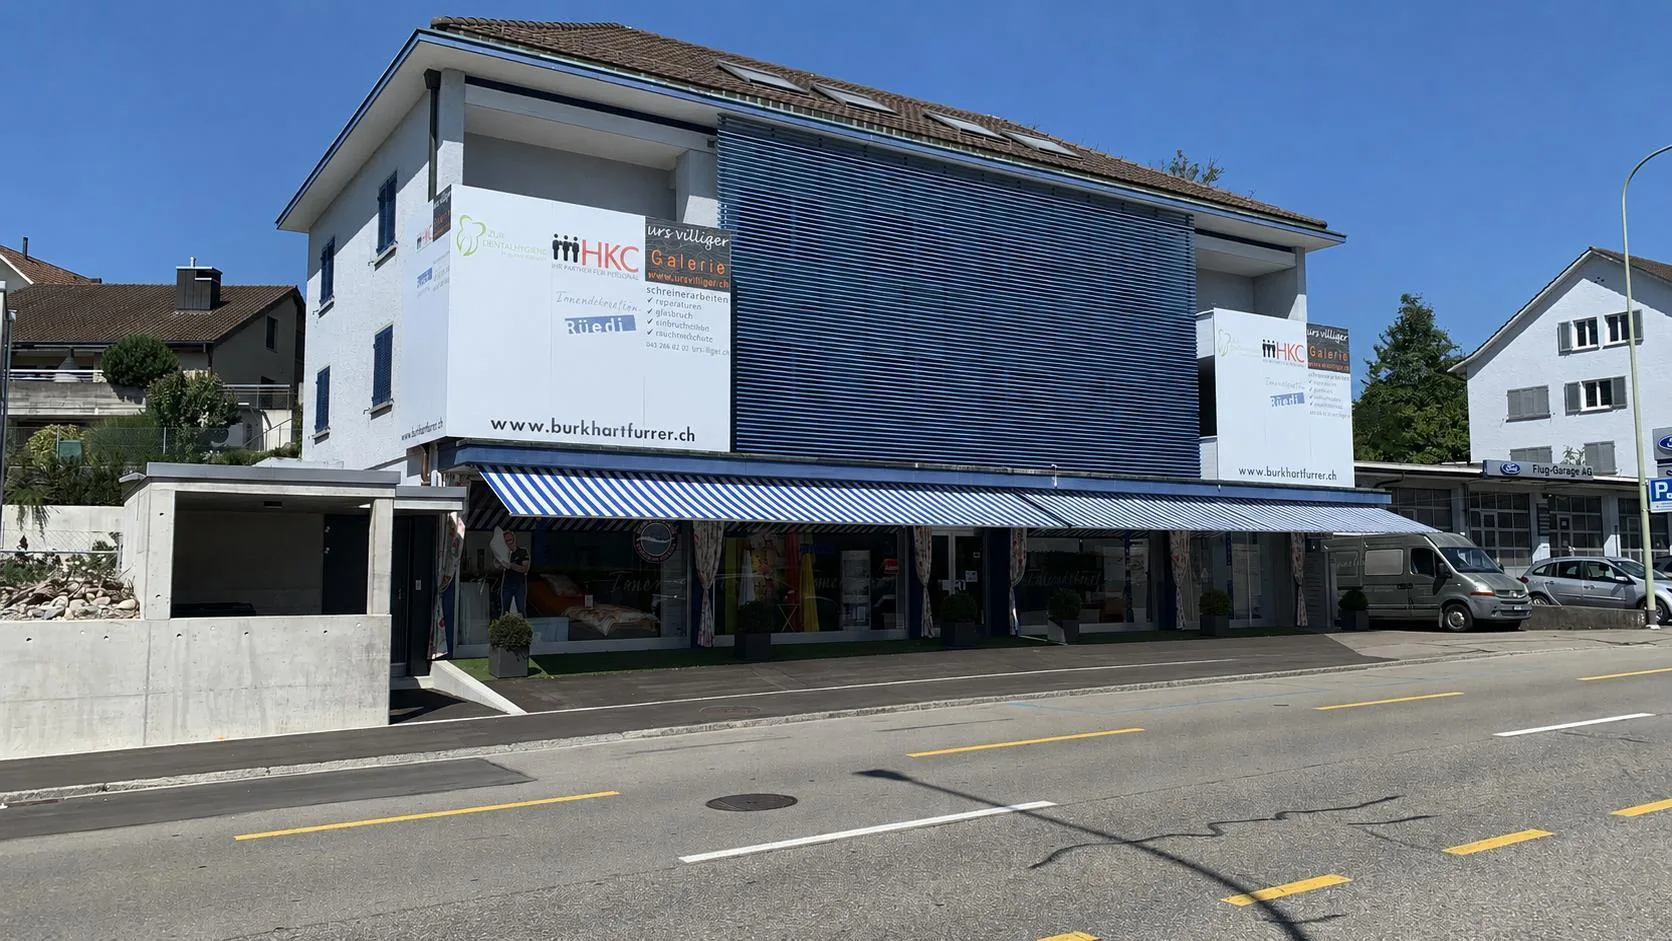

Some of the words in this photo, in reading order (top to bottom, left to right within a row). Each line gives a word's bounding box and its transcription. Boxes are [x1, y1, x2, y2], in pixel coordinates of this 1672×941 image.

[648, 225, 674, 239] urs
[675, 229, 729, 251] villiger
[582, 239, 639, 273] HKC
[651, 249, 725, 275] Galerie
[646, 286, 729, 304] schreinerarbeiten
[655, 298, 702, 310] reparaturen
[655, 308, 693, 320] glasbruch
[566, 317, 623, 334] Rüedi
[1307, 329, 1319, 337] urs
[1320, 329, 1348, 343] villiger
[1276, 342, 1305, 363] HKC
[1309, 345, 1348, 361] Galerie
[491, 417, 695, 442] www.burkhartfurrer.ch
[1239, 466, 1337, 480] www.burkhartfurrer.ch
[1532, 464, 1579, 477] Flug-Garage
[1581, 467, 1593, 476] AG
